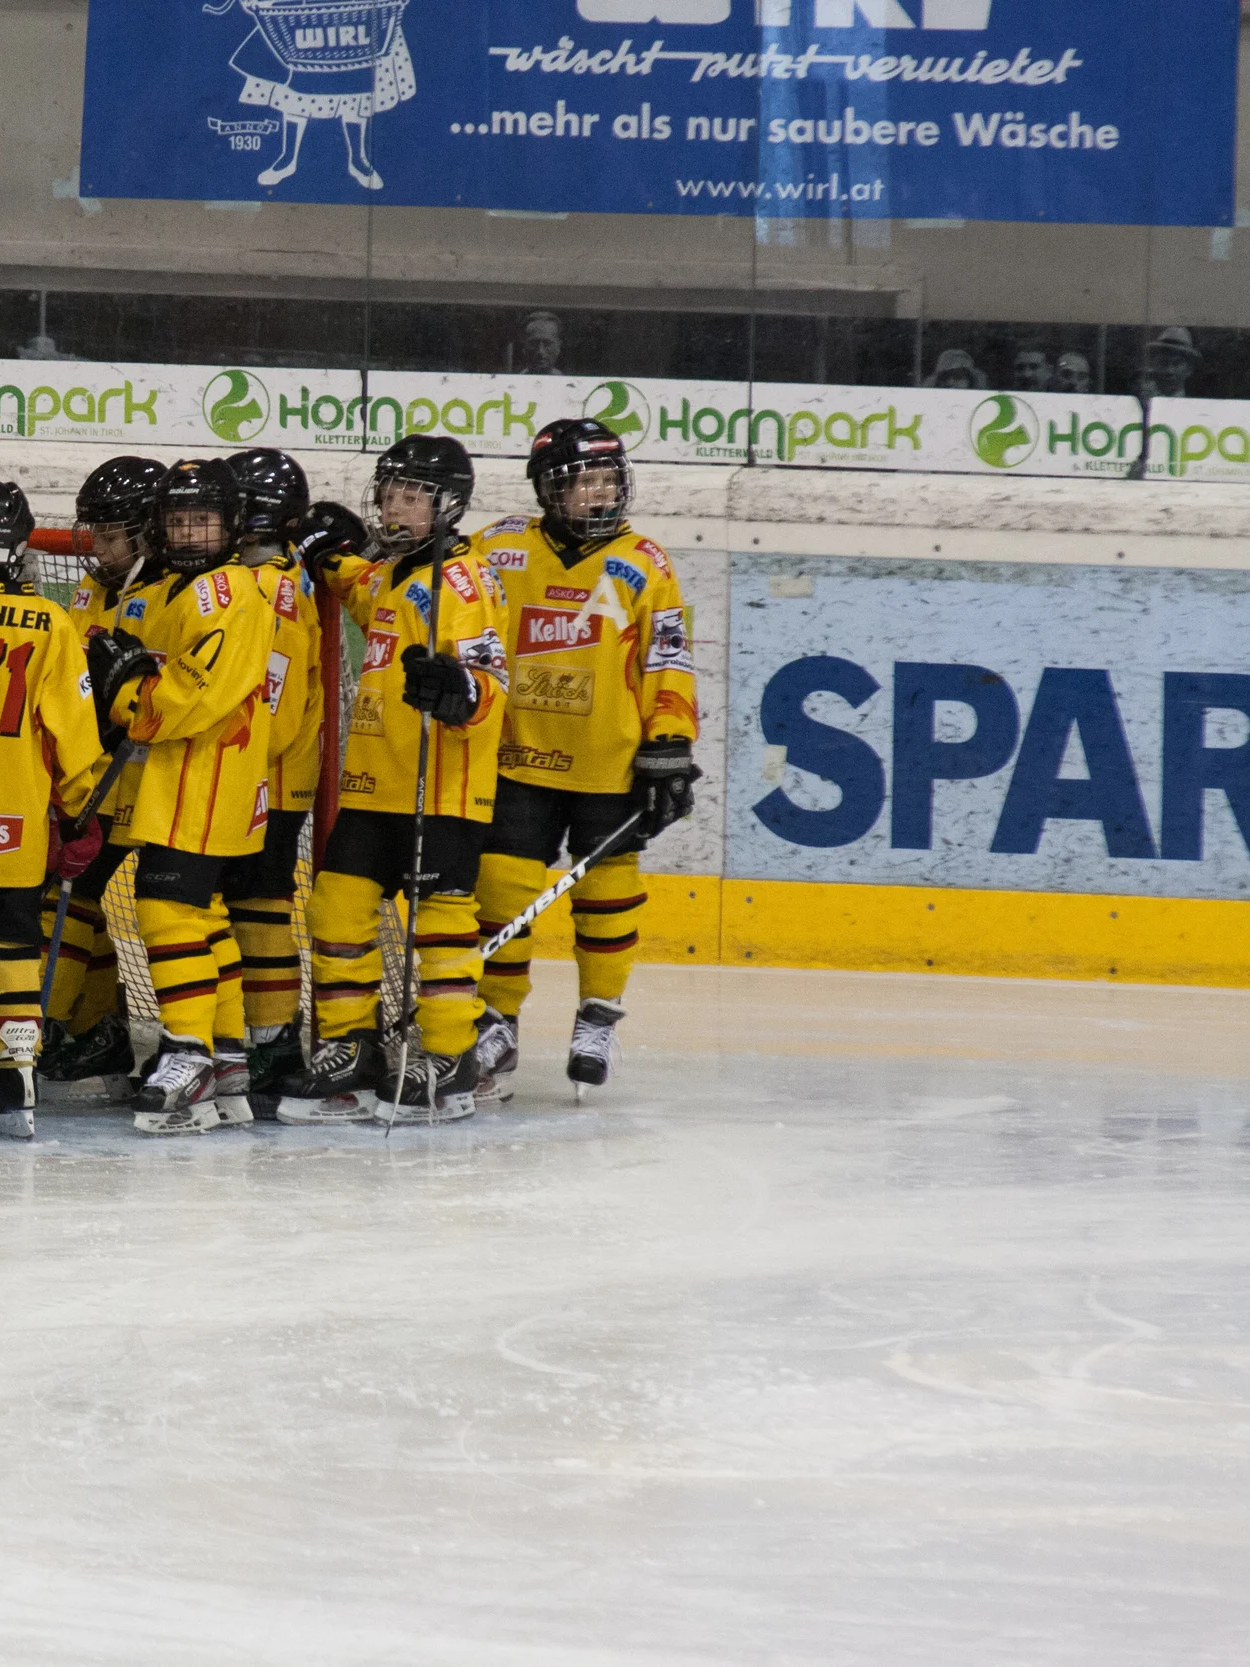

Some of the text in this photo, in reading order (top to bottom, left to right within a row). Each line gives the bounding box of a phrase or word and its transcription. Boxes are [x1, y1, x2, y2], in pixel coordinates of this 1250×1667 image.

[295, 25, 371, 49] WIRL
[489, 35, 665, 75] wäscht
[229, 135, 261, 150] 1930
[612, 103, 672, 141] als
[686, 116, 756, 143] nur
[767, 108, 941, 148] saubere
[954, 110, 1121, 151] Wäsche
[676, 174, 886, 202] www.wirl.at
[279, 385, 538, 445] Hornpark
[659, 397, 923, 462] Hornpark
[573, 572, 631, 630] A
[529, 616, 591, 645] Kellys
[497, 744, 574, 772] apitals
[752, 655, 1250, 861] SPAR
